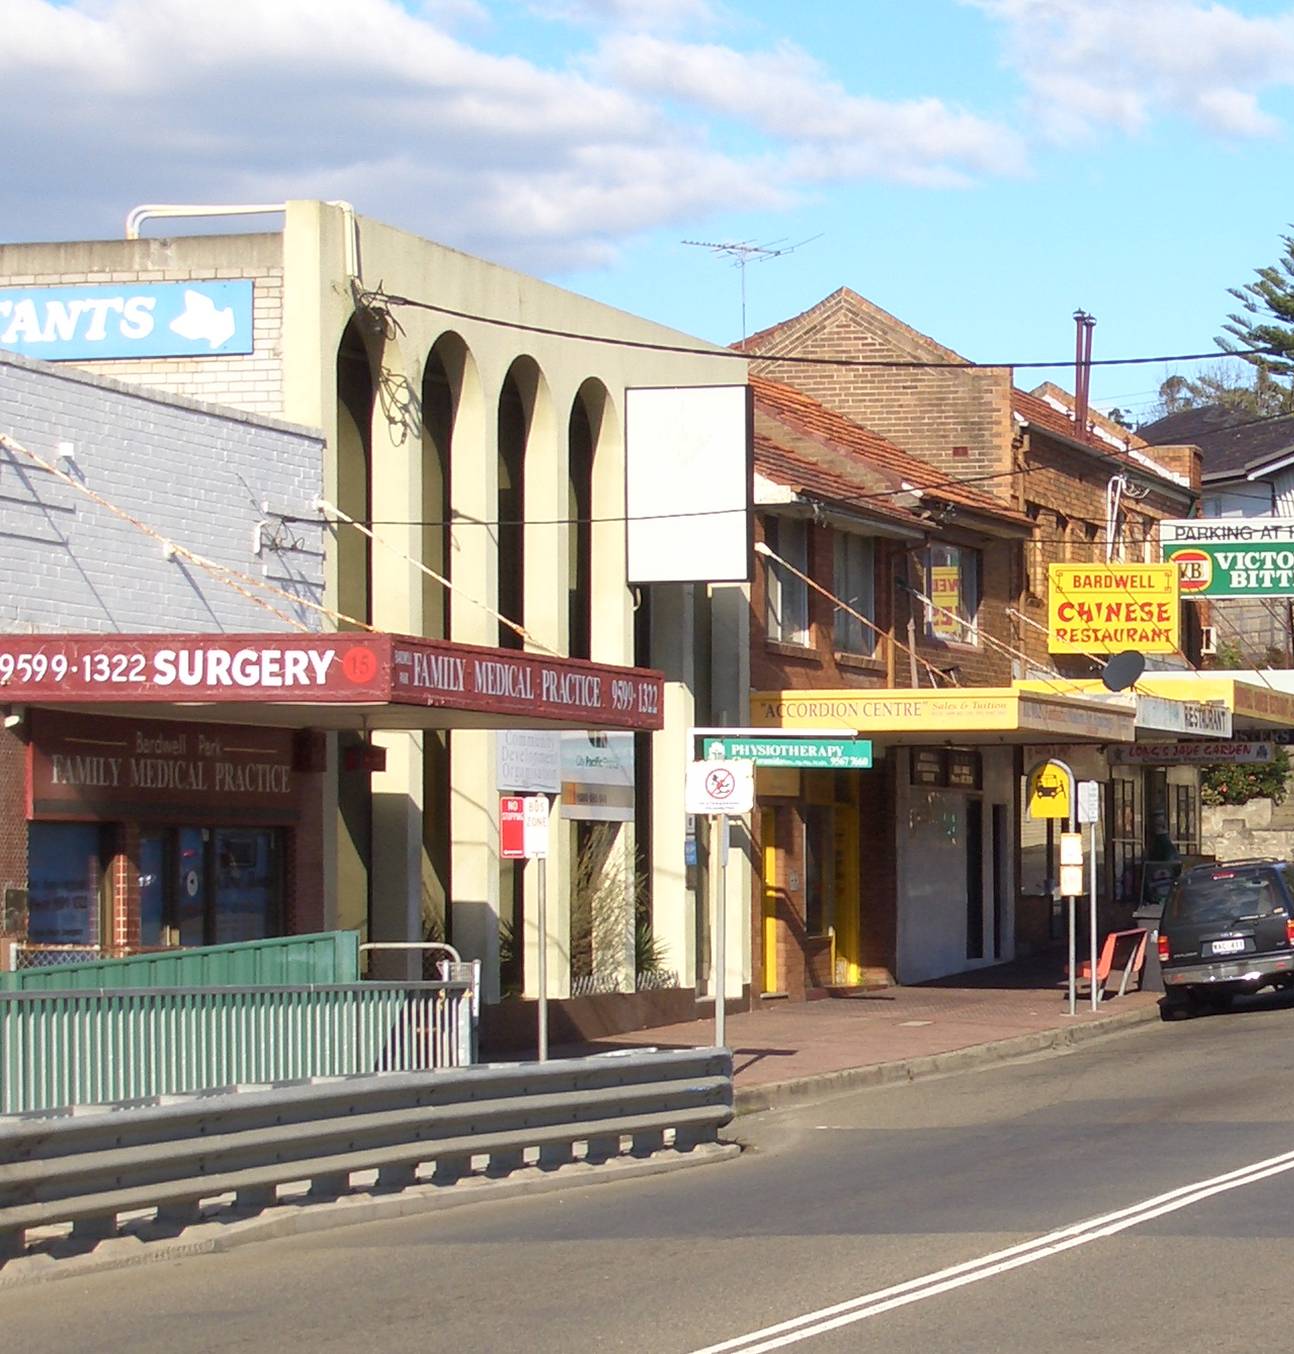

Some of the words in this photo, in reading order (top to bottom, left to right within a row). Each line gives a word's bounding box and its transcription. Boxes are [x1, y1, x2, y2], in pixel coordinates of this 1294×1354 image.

[1175, 525, 1254, 541] PARKING
[1261, 525, 1284, 540] AT
[1073, 574, 1155, 590] BARDWELL
[1057, 601, 1172, 623] CHINESE
[1056, 627, 1173, 644] RESTAURANT
[153, 648, 336, 687] SURGERY
[413, 652, 466, 692] FAMILY
[474, 660, 534, 700] MEDICAL
[542, 669, 602, 707] PRACTICE
[931, 702, 958, 711] Sales
[731, 744, 844, 757] PHYSIOTHERAPY
[1202, 743, 1251, 756] GARDEN
[51, 754, 123, 787] FAMILY
[130, 758, 207, 791] MEDICAL
[215, 763, 291, 793] PRACTICE
[507, 800, 519, 812] NO
[528, 803, 545, 813] BUS
[527, 816, 548, 827] ZONE
